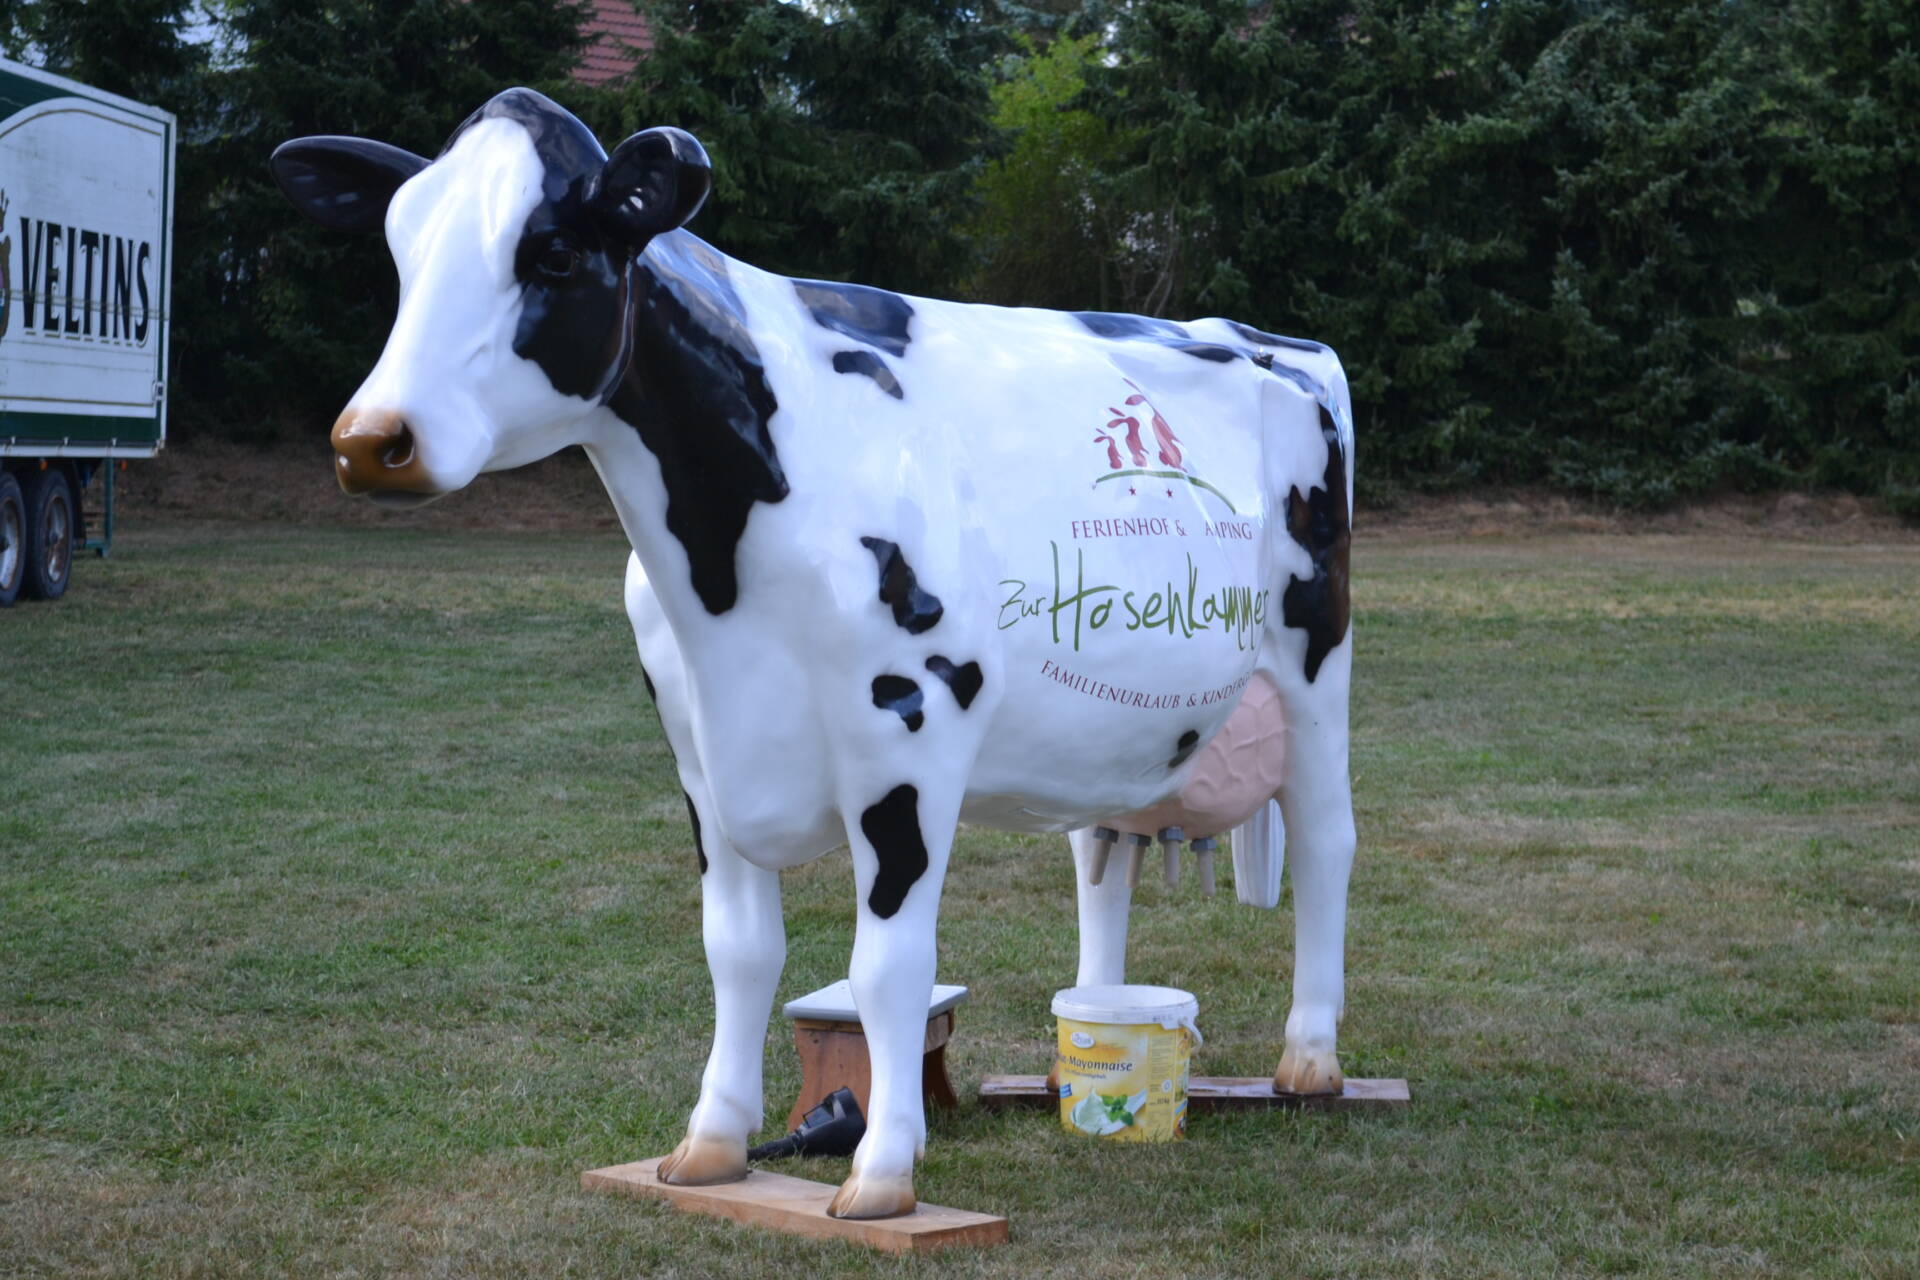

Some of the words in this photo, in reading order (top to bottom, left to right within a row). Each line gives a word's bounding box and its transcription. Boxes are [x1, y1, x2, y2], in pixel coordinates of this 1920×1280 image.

[20, 216, 151, 347] VELTINS
[1071, 518, 1169, 539] FERIENHOF
[1175, 519, 1188, 536] &
[1204, 520, 1253, 541] APING
[997, 580, 1047, 630] Zur
[1040, 660, 1180, 709] FAMILIENURLAUB
[1186, 693, 1197, 707] &
